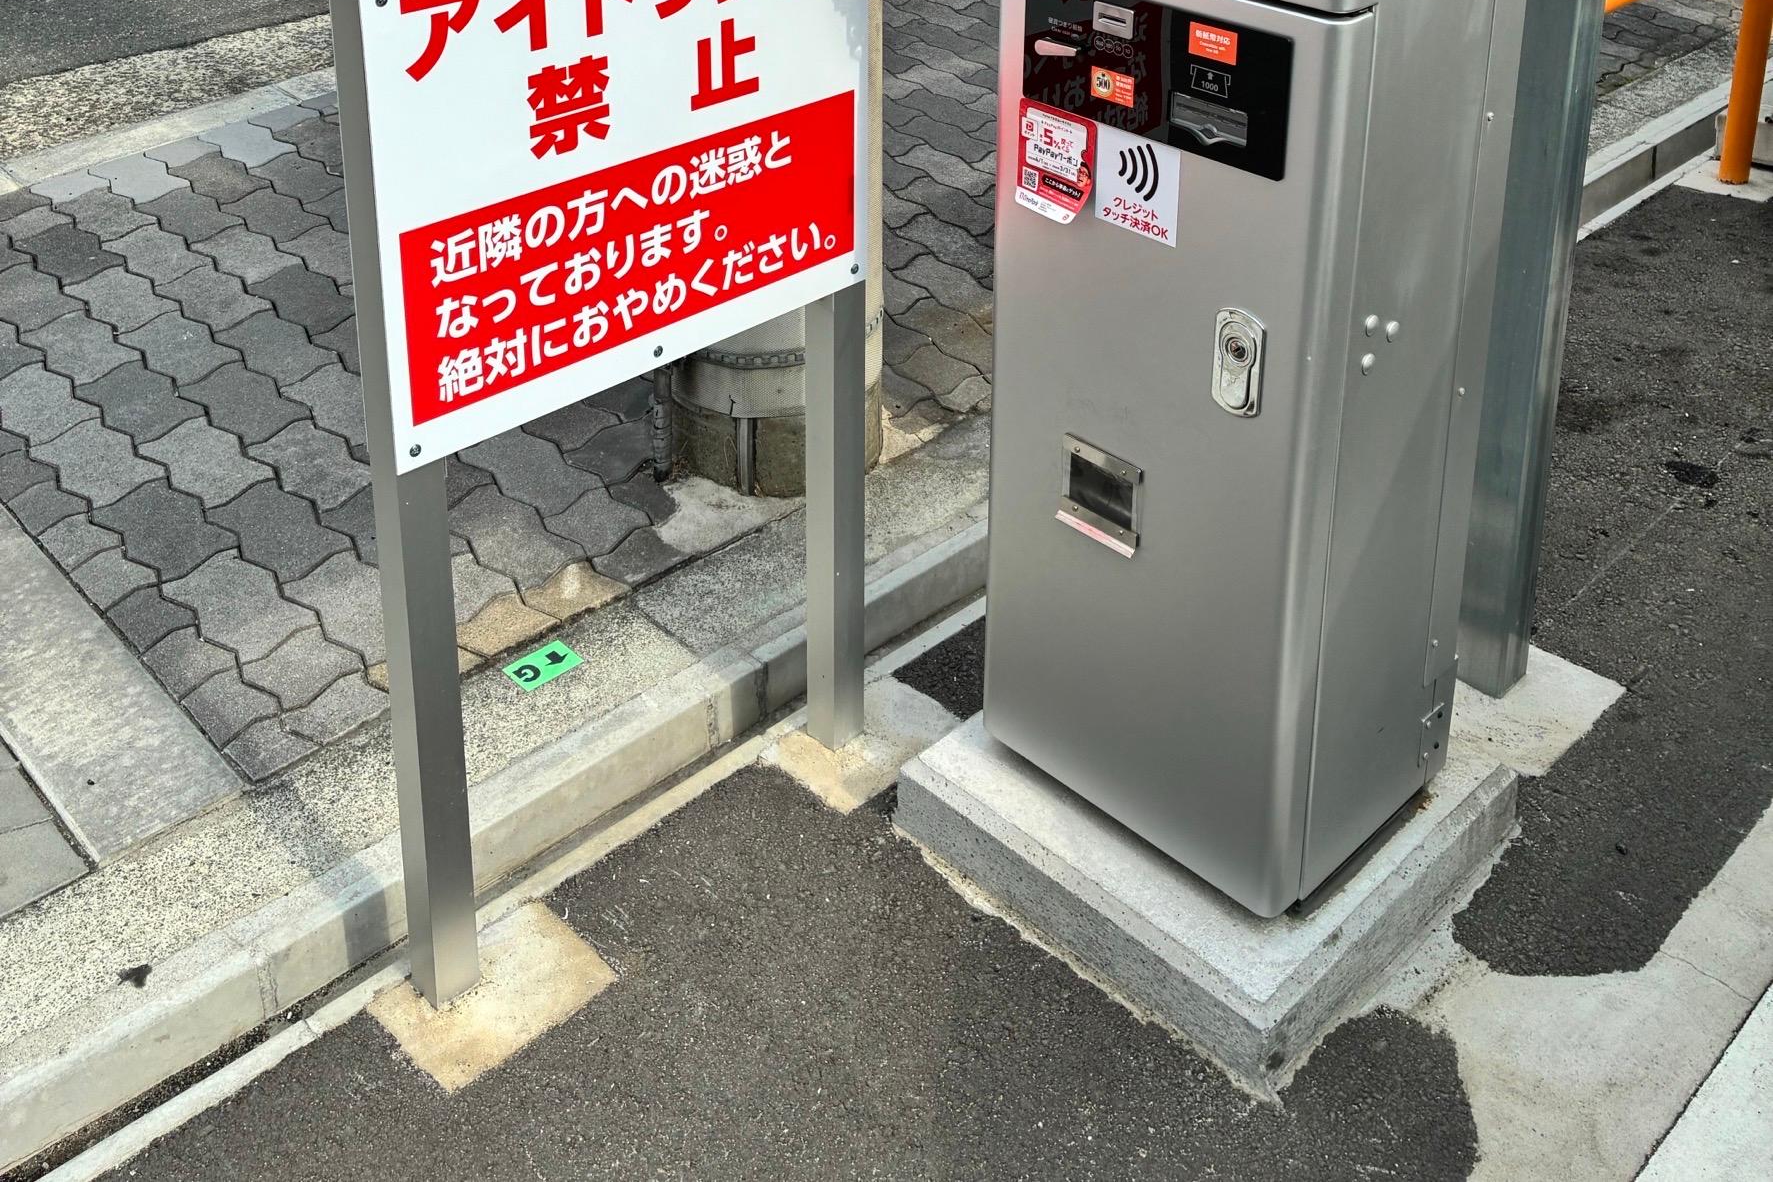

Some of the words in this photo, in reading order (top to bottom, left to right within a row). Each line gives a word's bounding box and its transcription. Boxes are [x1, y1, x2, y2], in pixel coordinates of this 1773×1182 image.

[1201, 80, 1219, 92] 1000
[1034, 143, 1078, 167] PayPayクーポン
[430, 130, 792, 288] 近隣の方への迷惑と
[1103, 206, 1169, 240] タッチ決済OK
[1113, 196, 1159, 221] クレジット
[436, 209, 728, 339] なっております。
[438, 221, 837, 403] 絶対におやめください。
